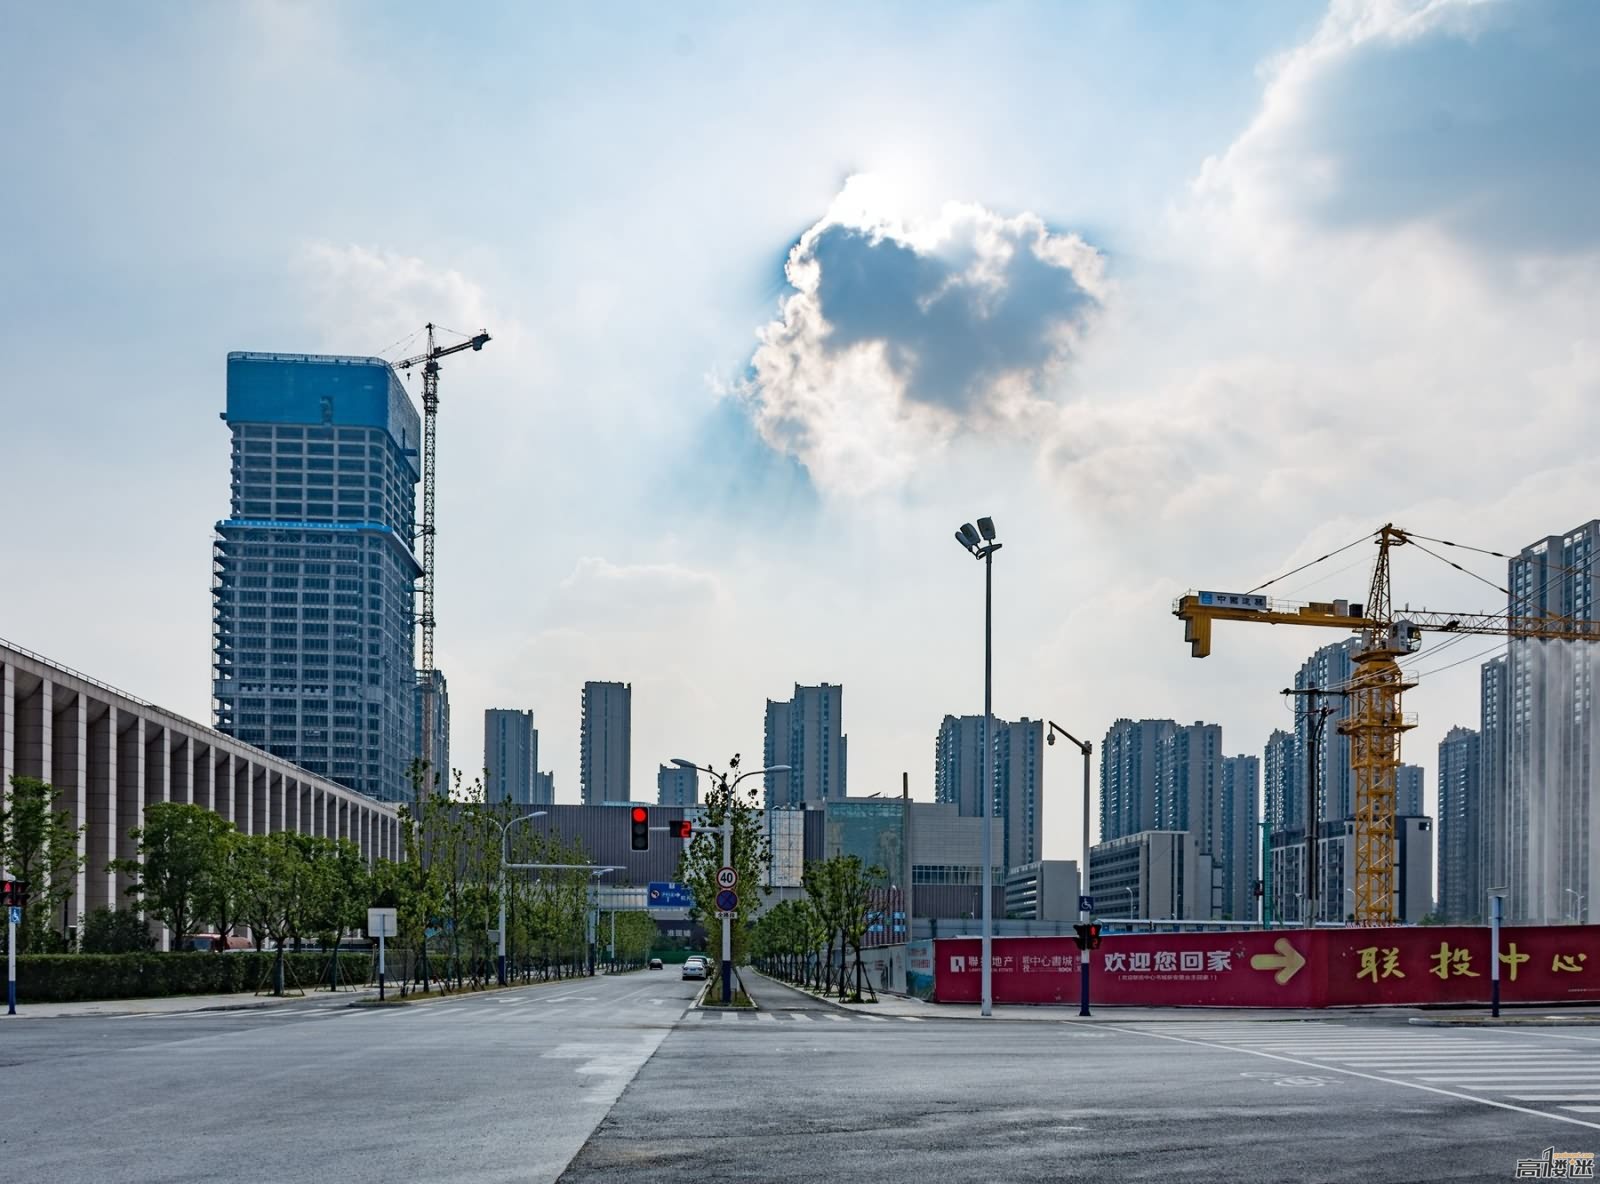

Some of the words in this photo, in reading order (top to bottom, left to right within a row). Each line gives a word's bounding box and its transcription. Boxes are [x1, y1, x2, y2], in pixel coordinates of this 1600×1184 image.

[681, 822, 690, 837] 2
[720, 872, 733, 883] 40
[1104, 951, 1232, 972] 欢迎您回家
[1356, 941, 1587, 983] 联投中心
